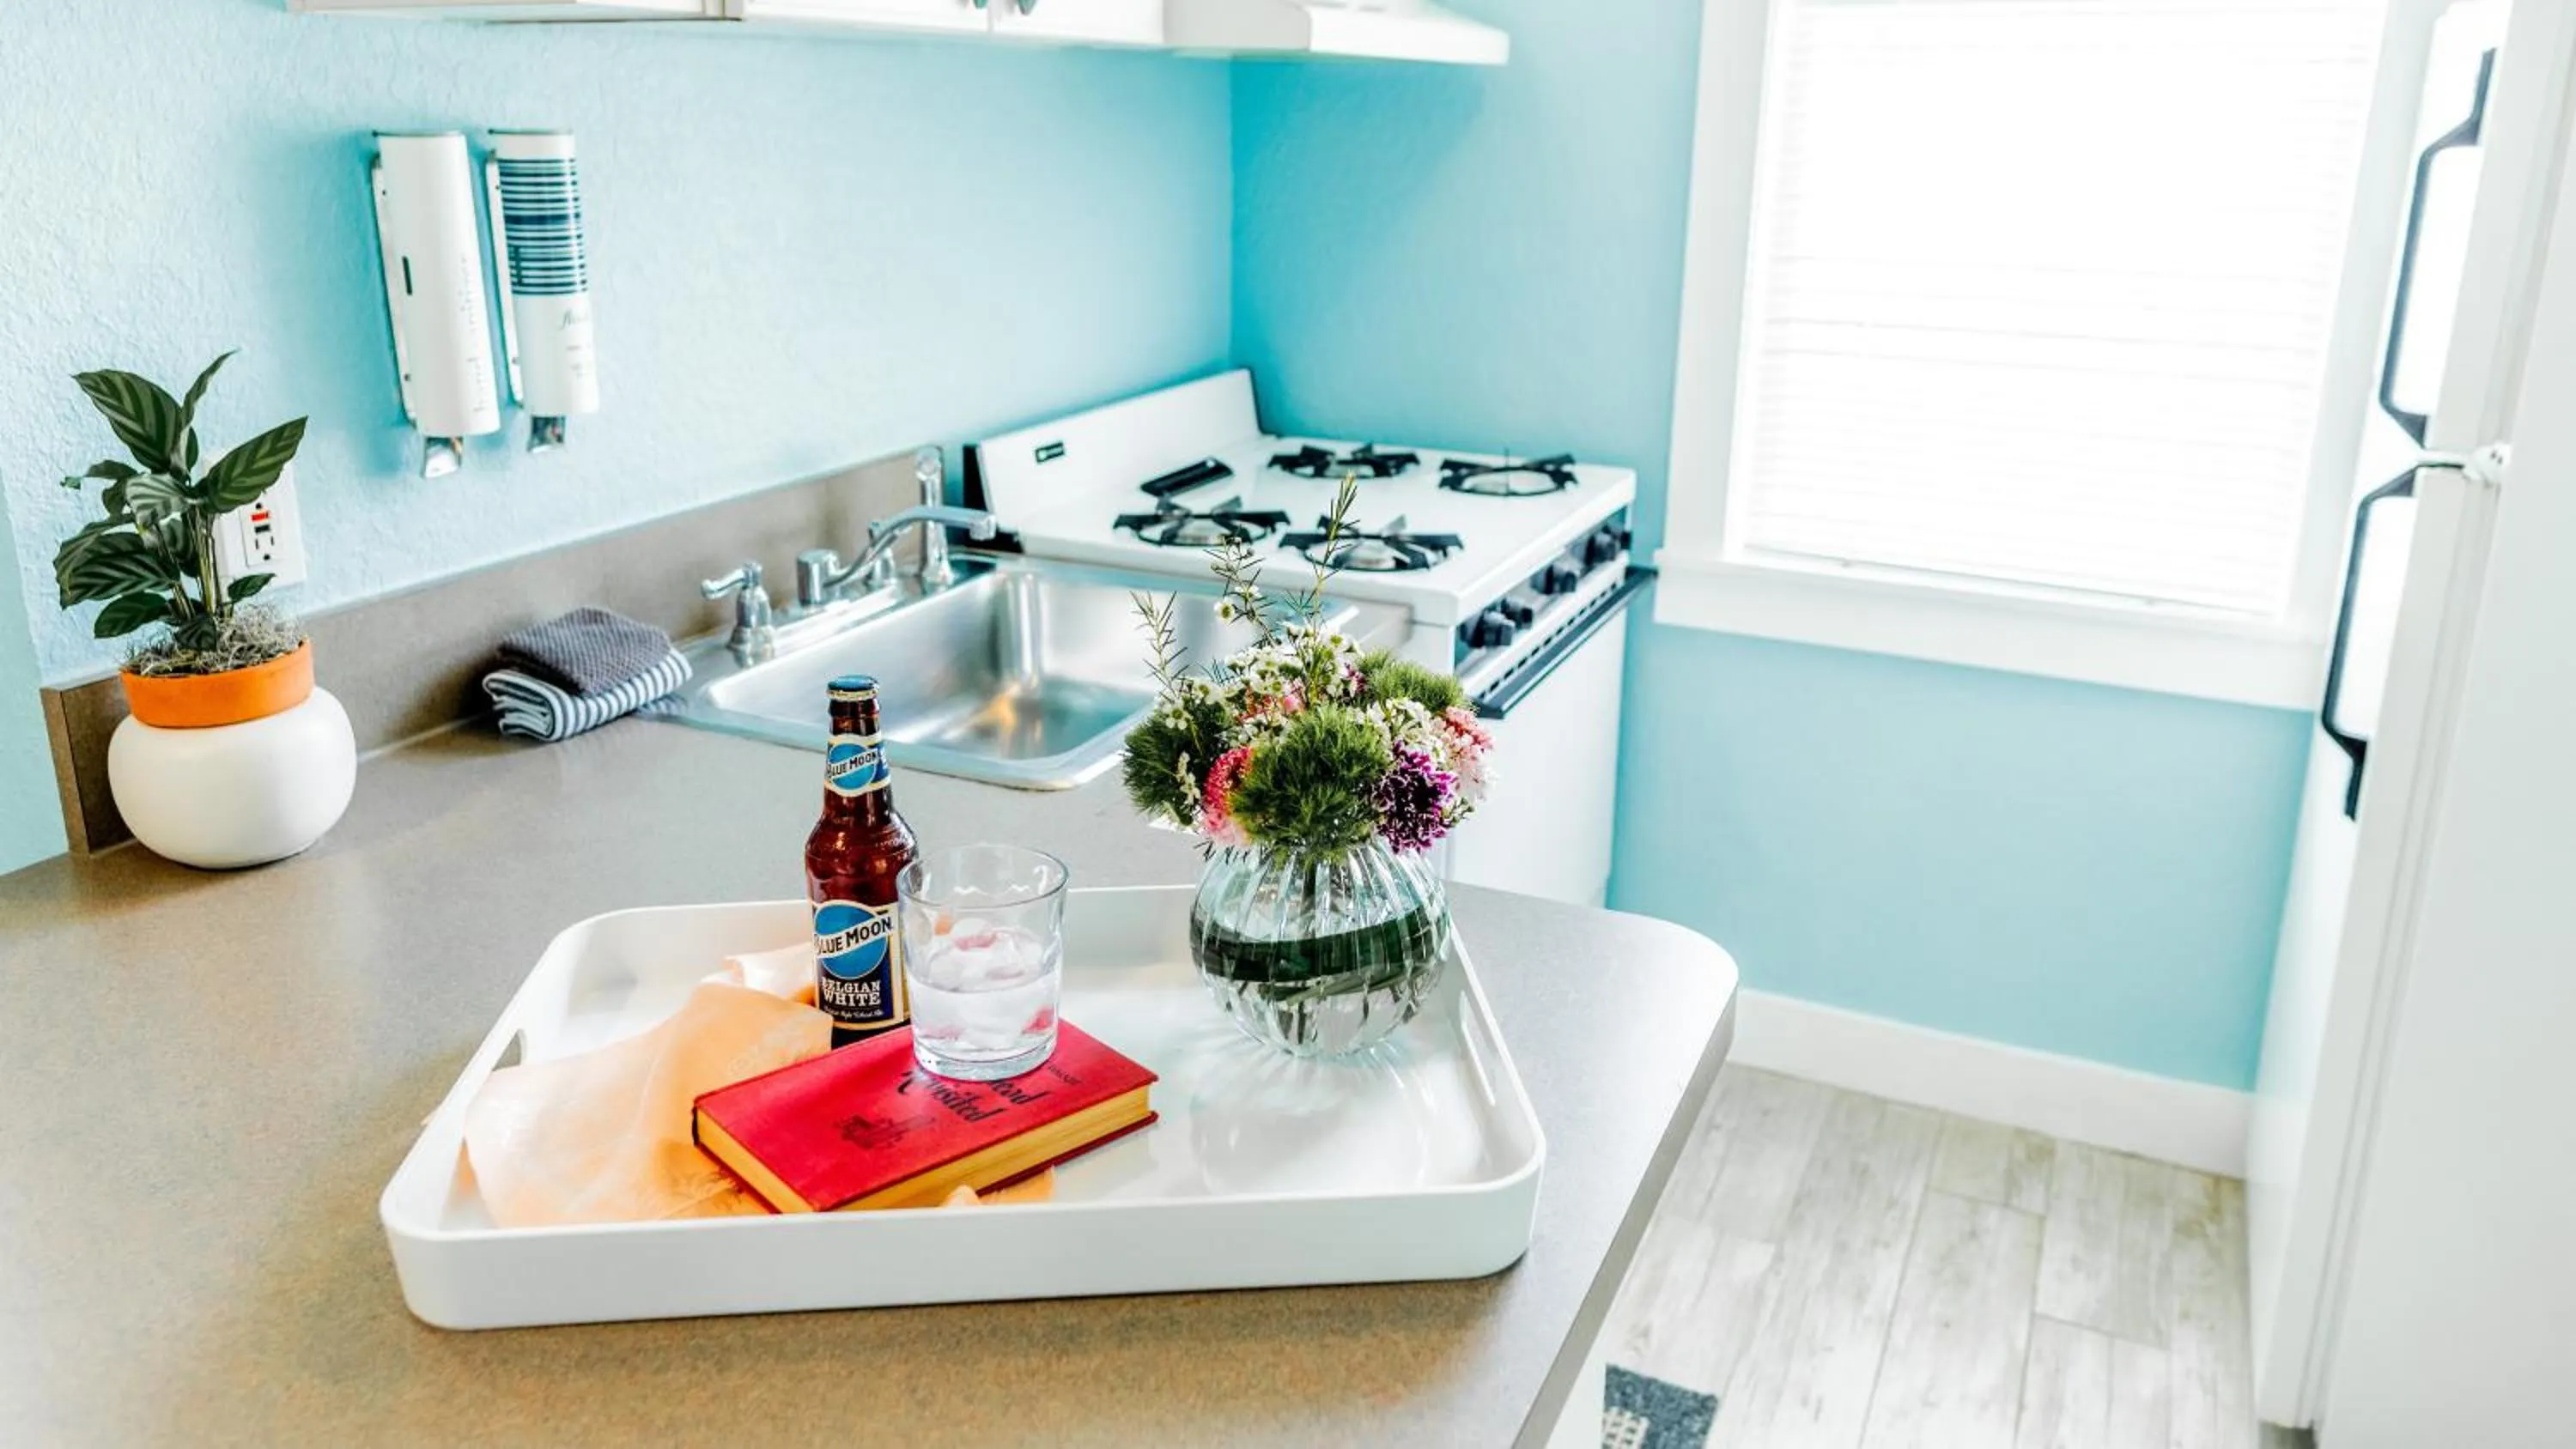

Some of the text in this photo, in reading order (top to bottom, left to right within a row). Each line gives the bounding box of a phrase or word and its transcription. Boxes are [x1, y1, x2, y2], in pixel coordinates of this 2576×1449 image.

[849, 752, 878, 770] MOON
[845, 917, 891, 948] MOON
[823, 989, 882, 1007] WHITE
